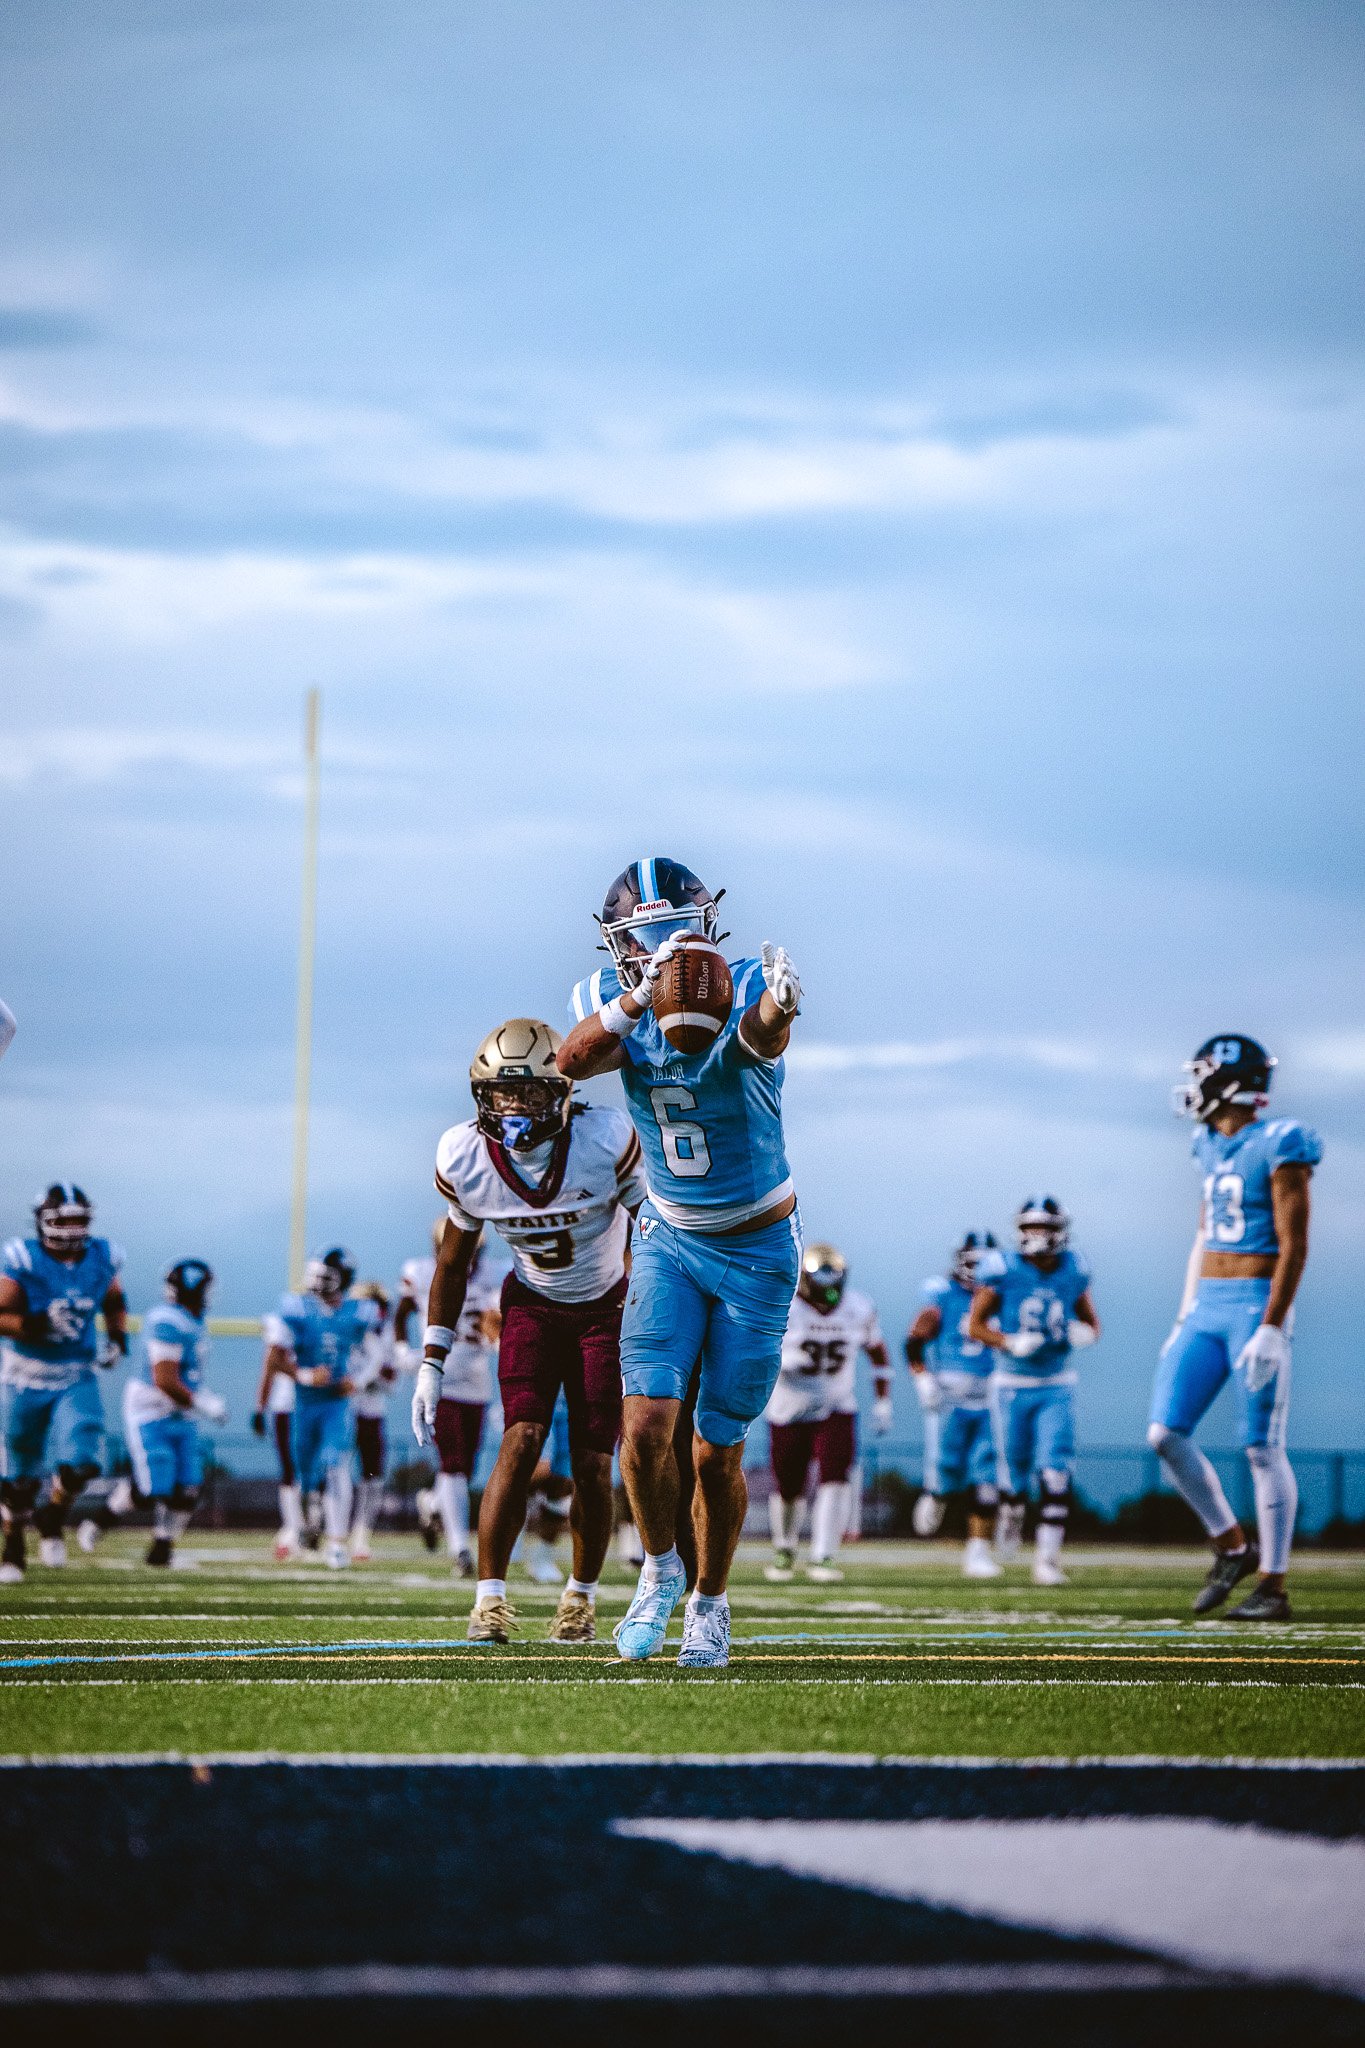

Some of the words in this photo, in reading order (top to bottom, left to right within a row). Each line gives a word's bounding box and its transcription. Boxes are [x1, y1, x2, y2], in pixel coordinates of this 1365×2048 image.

[636, 900, 667, 912] Riddell
[697, 961, 710, 999] Wilson
[649, 1085, 713, 1178] 6
[508, 1210, 579, 1228] FAITH
[1204, 1173, 1246, 1243] 13
[523, 1229, 574, 1270] 3
[801, 1339, 847, 1376] 35
